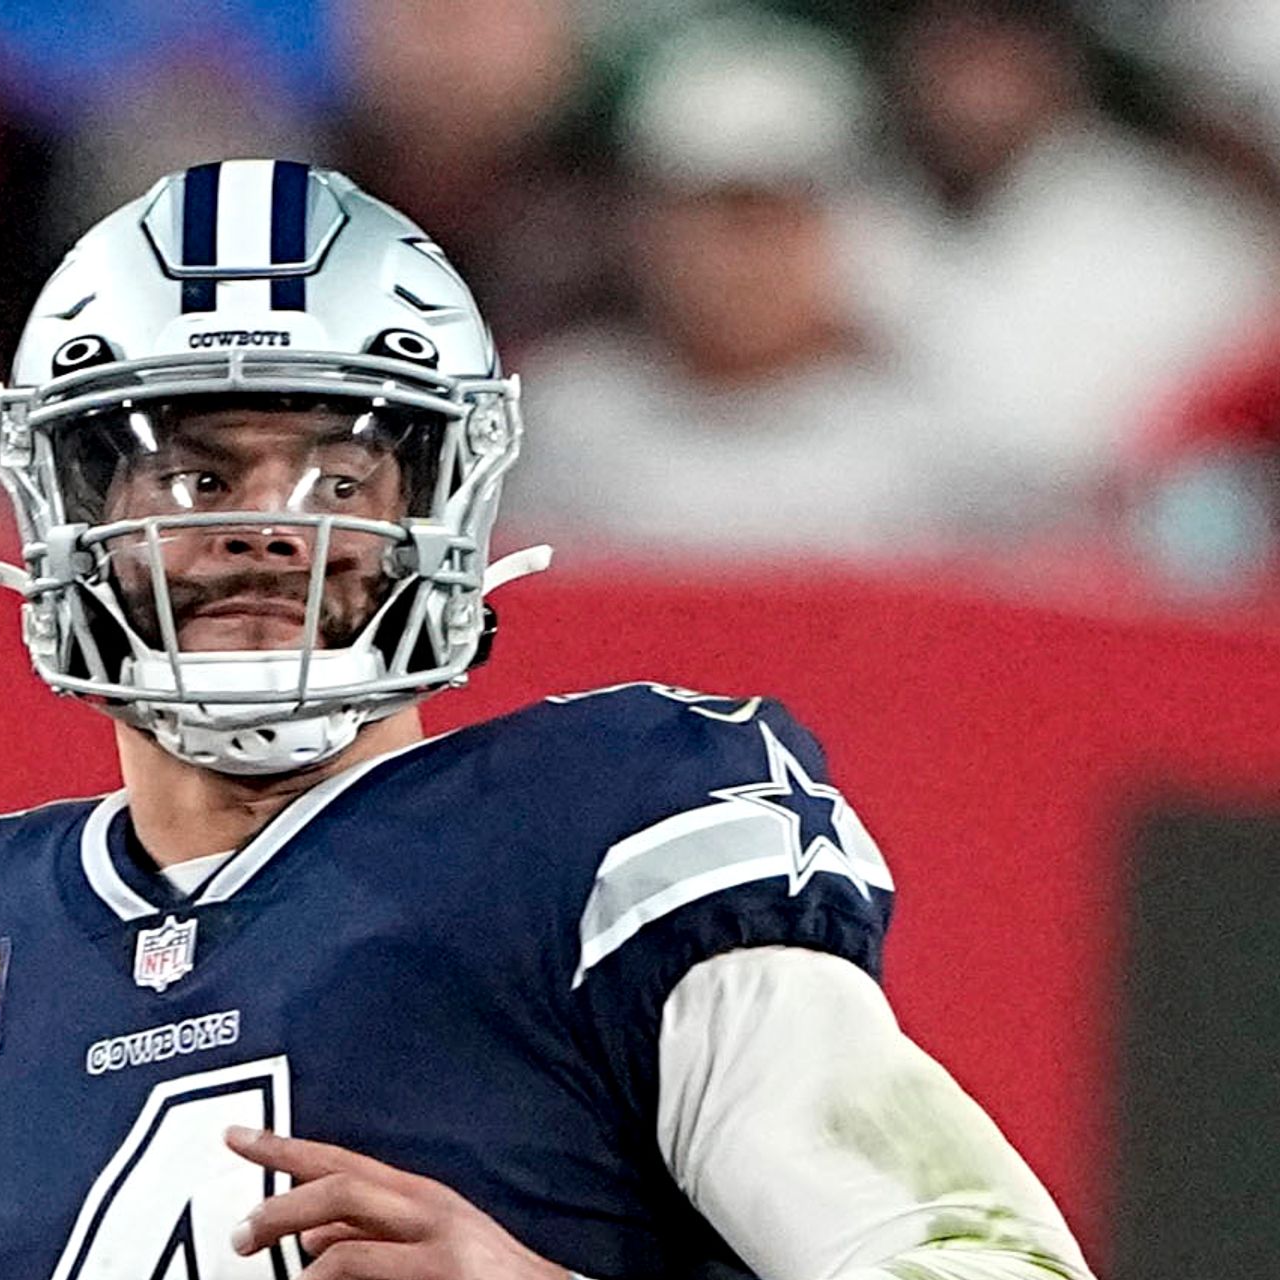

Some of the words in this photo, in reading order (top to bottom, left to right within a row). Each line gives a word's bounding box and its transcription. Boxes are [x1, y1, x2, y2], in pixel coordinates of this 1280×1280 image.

[189, 331, 291, 349] COWBOYS
[143, 948, 183, 975] NFL
[87, 1009, 240, 1075] COWBOYS
